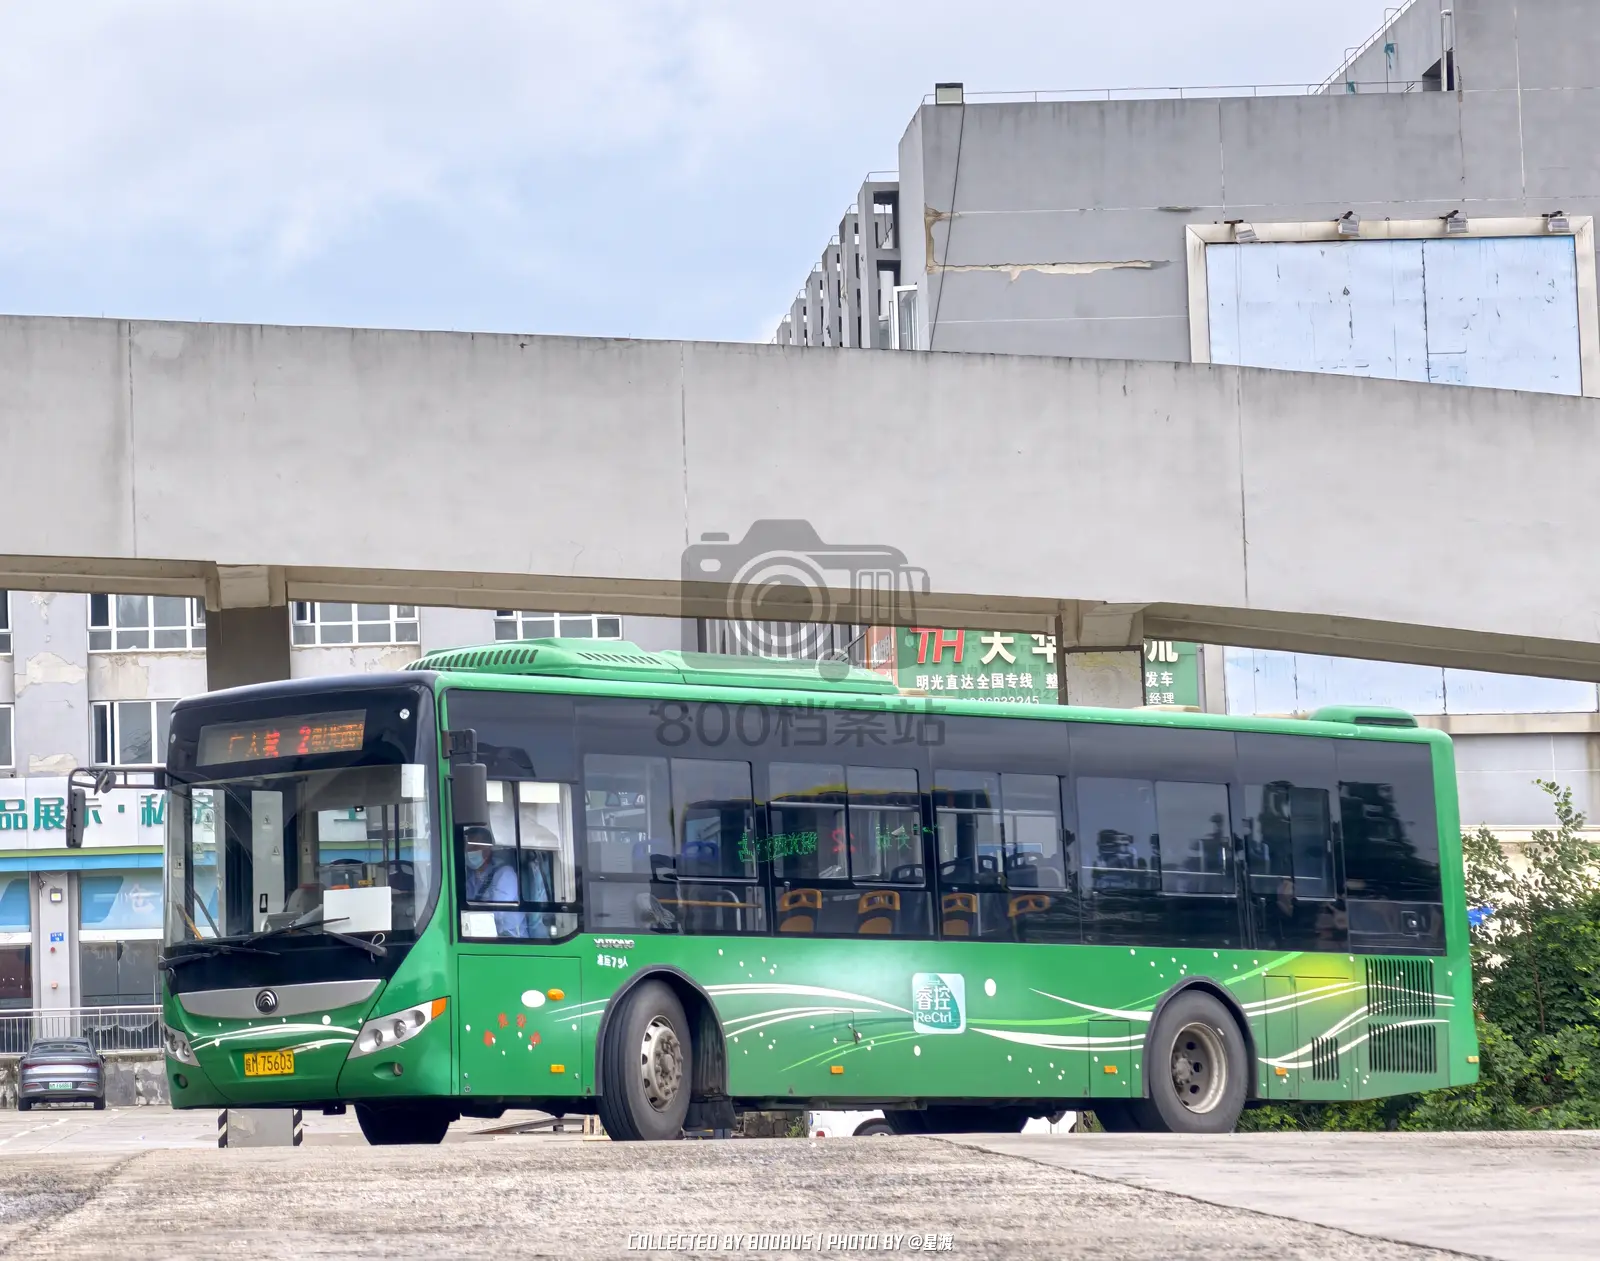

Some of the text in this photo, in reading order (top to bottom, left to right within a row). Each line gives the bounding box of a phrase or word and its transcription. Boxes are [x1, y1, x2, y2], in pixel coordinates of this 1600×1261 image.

[916, 673, 1033, 690] 明光直达全国专线
[1146, 692, 1175, 705] 经理
[916, 985, 952, 1011] 睿控
[916, 1011, 952, 1023] ReCtrl
